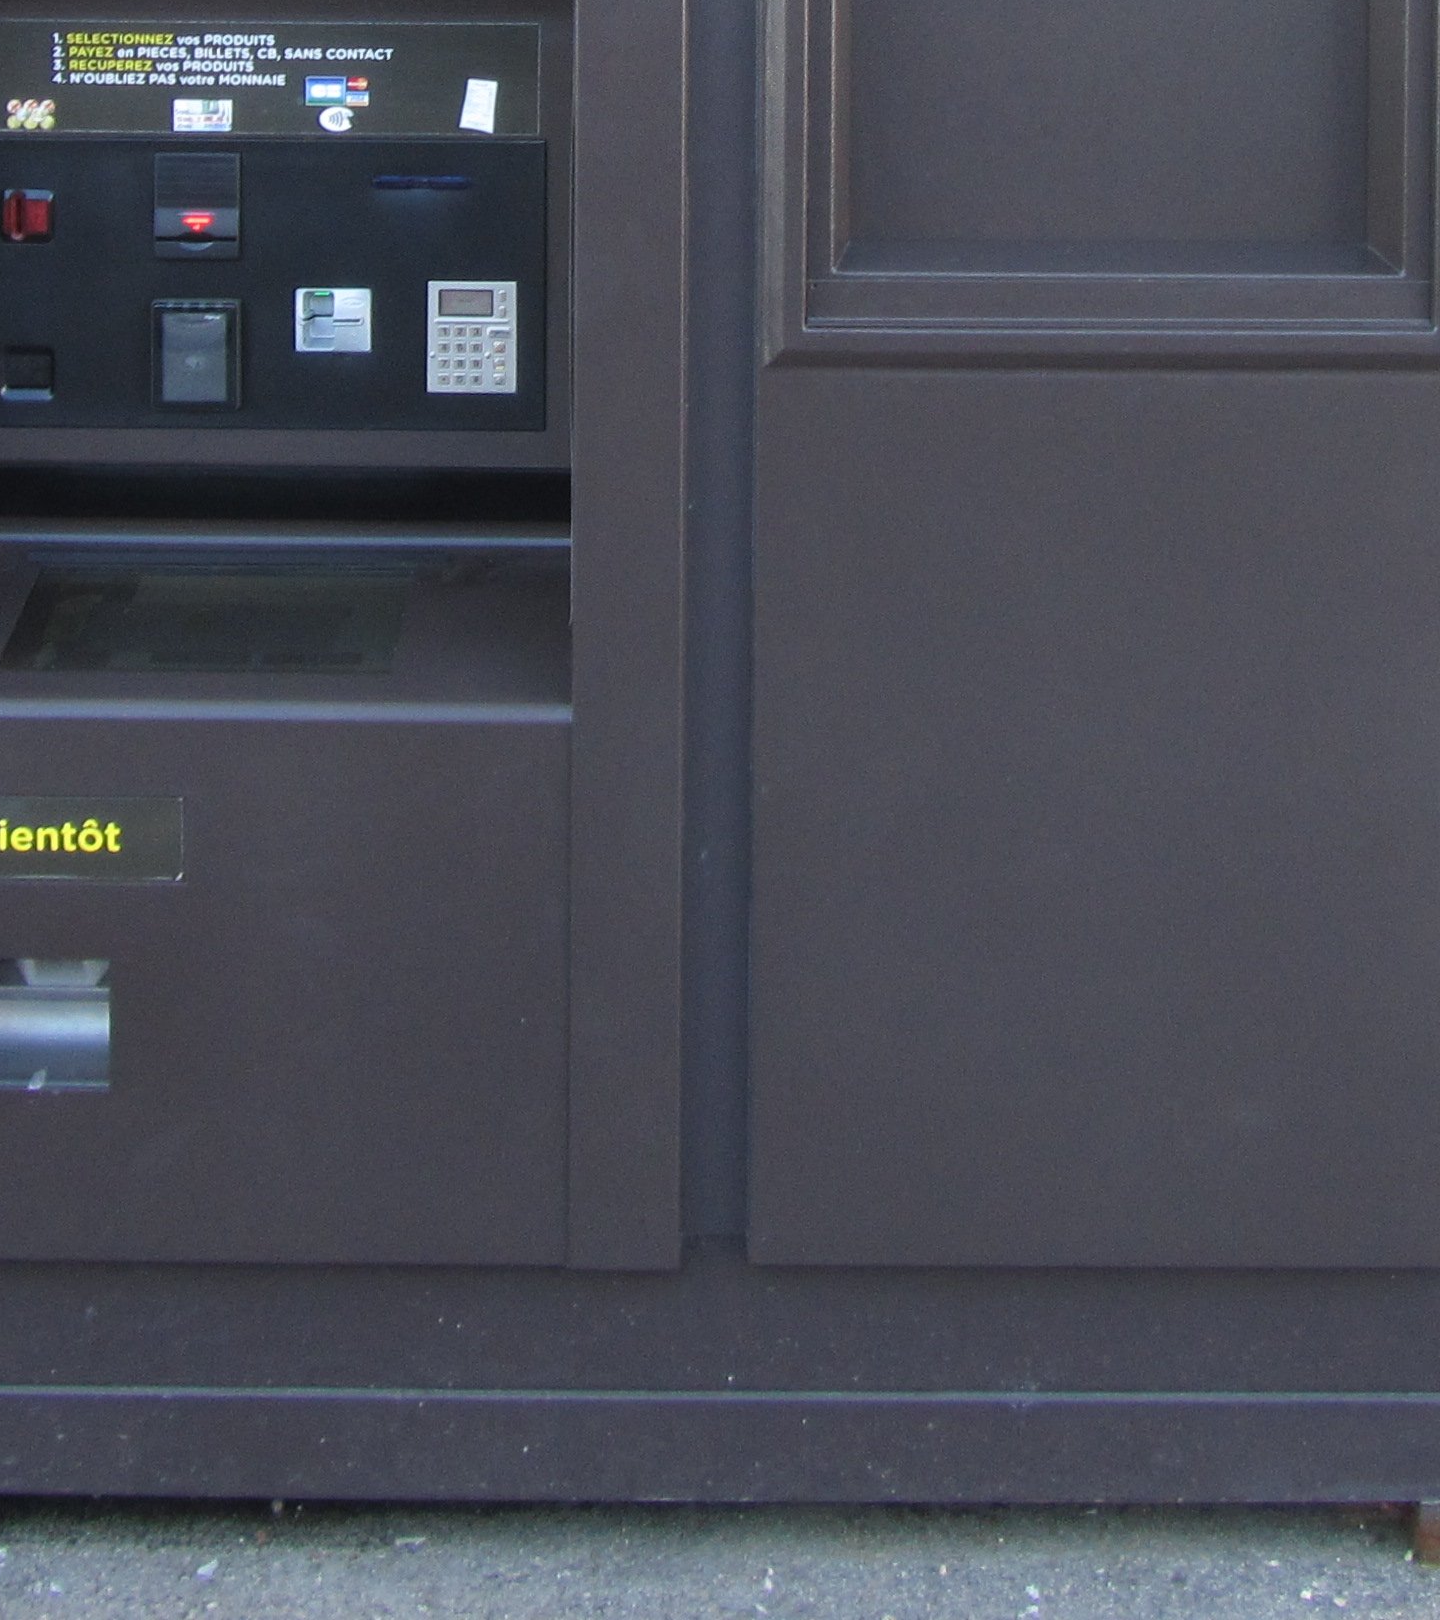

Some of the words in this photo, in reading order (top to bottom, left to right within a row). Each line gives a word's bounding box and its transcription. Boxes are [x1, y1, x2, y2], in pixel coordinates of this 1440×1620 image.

[52, 32, 63, 45] 1.
[66, 32, 174, 45] SELECTIONNEZ
[176, 36, 201, 46] vos
[204, 34, 276, 46] PRODUITS
[52, 46, 65, 58] 2.
[68, 46, 115, 58] PAYEZ
[117, 48, 134, 58] en
[137, 47, 191, 60] PIECES,
[194, 48, 254, 60] BILLETS,
[257, 48, 282, 61] CB,
[284, 48, 323, 60] SANS
[325, 48, 394, 61] CONTACT
[52, 60, 66, 71] 3.
[68, 59, 153, 72] RECUPEREZ
[155, 62, 180, 72] vos
[182, 60, 255, 73] PRODUITS
[51, 72, 67, 85] 4.
[70, 73, 146, 85] N'OUBLIEZ
[149, 73, 177, 85] PAS
[179, 74, 215, 86] votre
[219, 74, 287, 87] MONNAIE
